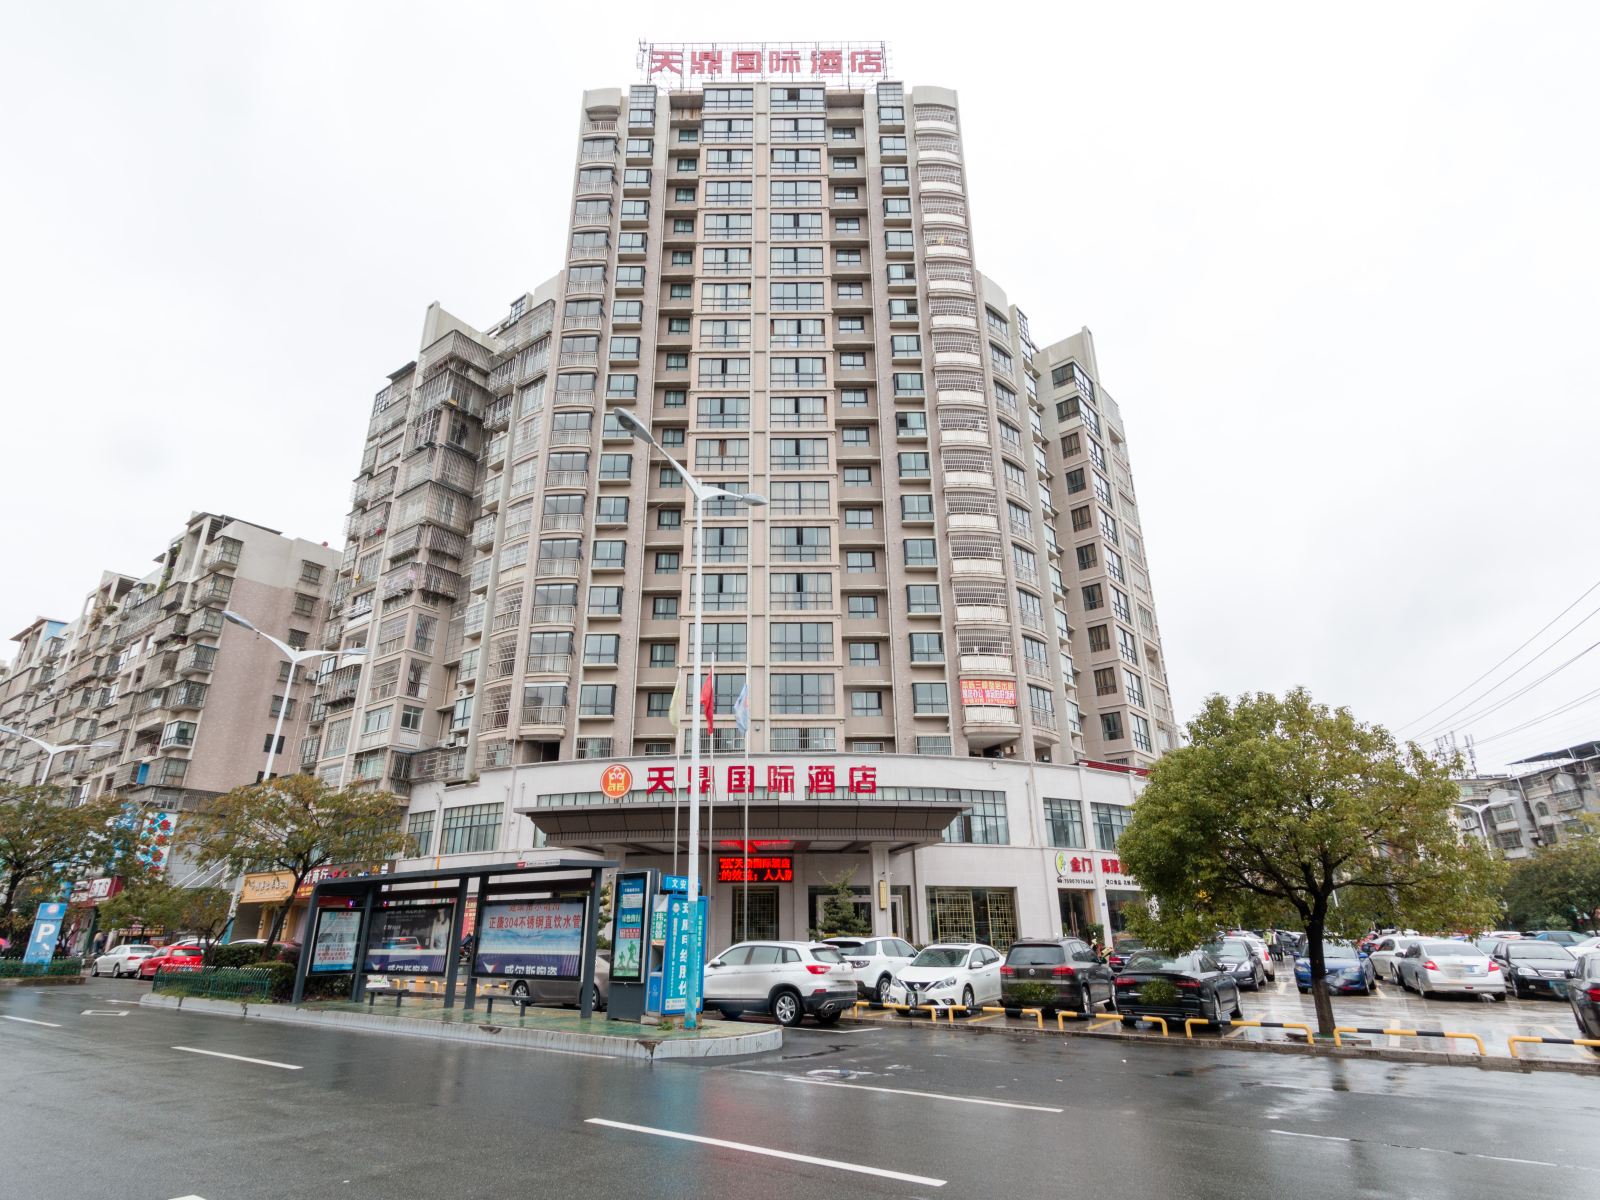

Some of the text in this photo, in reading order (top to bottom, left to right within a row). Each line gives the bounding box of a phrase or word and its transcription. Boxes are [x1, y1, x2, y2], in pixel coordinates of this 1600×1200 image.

[650, 49, 882, 75] 天鼎国际酒店
[646, 765, 877, 795] 天鼎国际酒店
[35, 923, 56, 943] P
